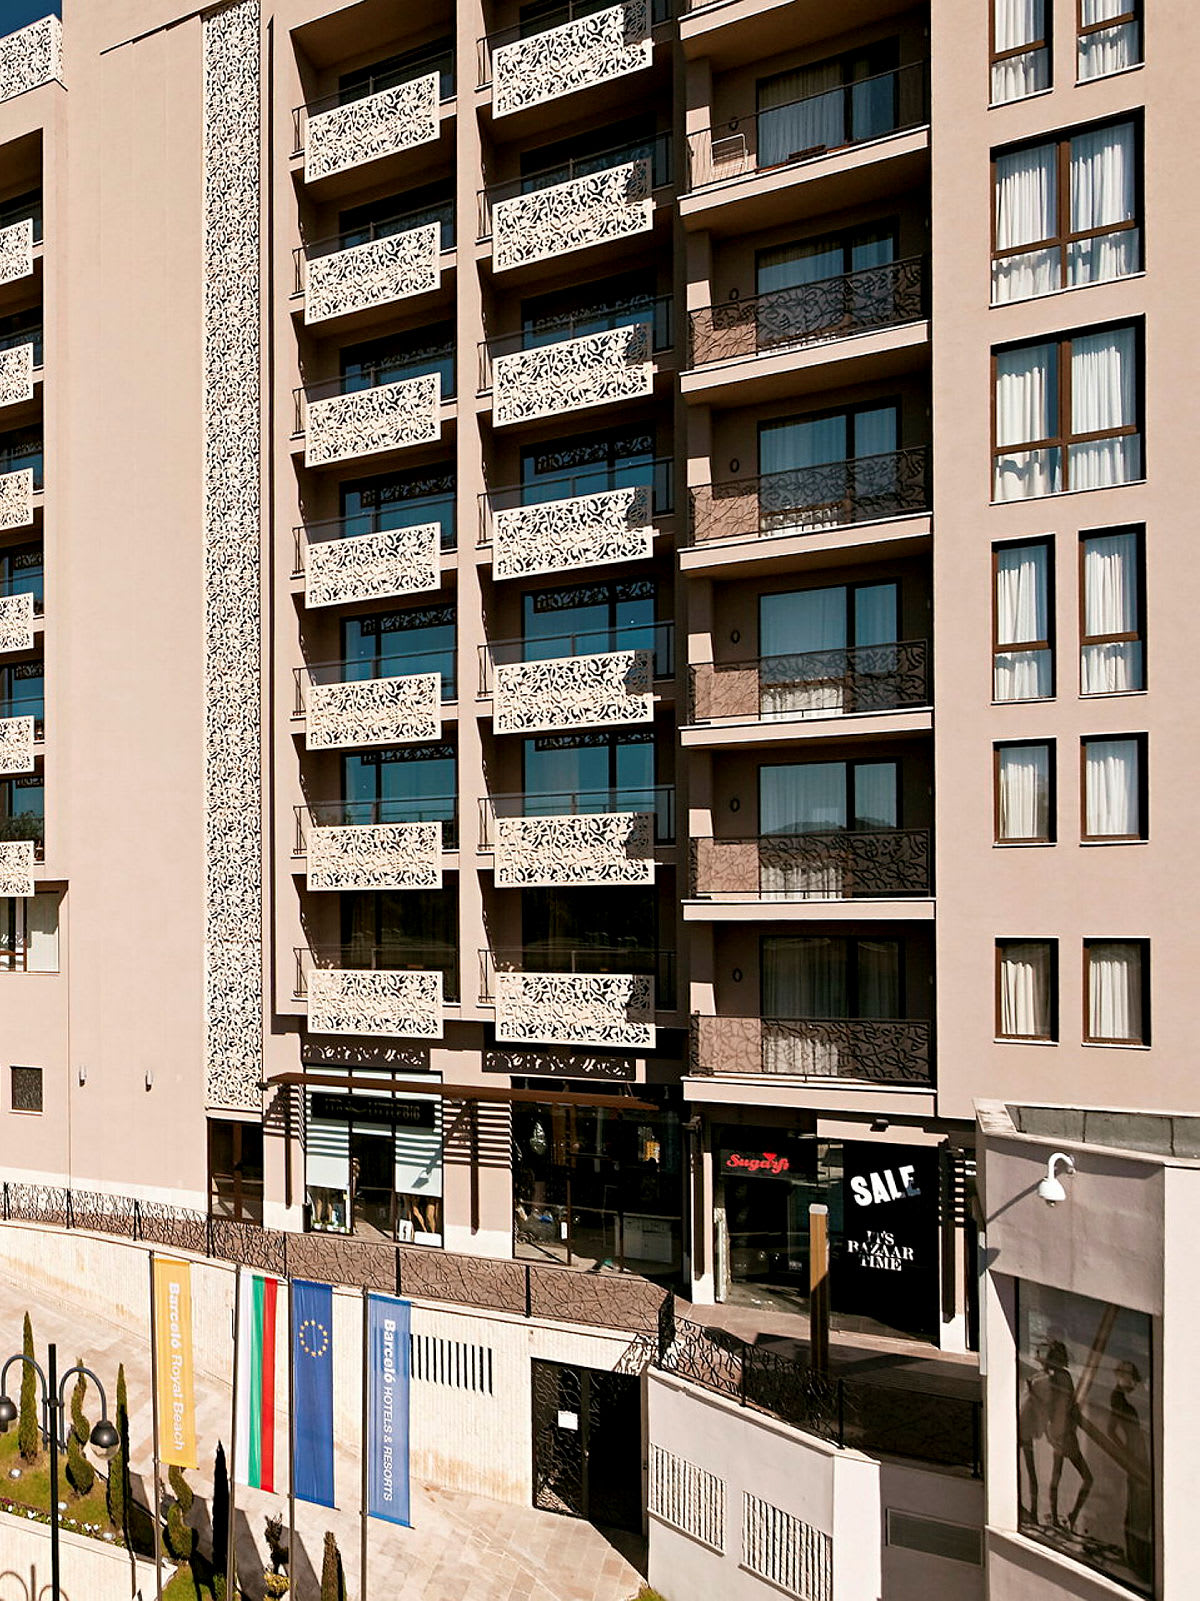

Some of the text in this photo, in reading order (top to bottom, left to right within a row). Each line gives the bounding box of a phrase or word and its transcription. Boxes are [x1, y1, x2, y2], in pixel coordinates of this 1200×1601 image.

[850, 1165, 921, 1206] SALE
[847, 1240, 914, 1261] BAZAAR
[866, 1230, 895, 1246] IT'S
[859, 1254, 902, 1271] TIME
[169, 1282, 186, 1450] Barceló Royal Beach
[383, 1318, 397, 1384] Barceló
[383, 1386, 393, 1433] HOTELS
[382, 1445, 393, 1501] RESORTS
